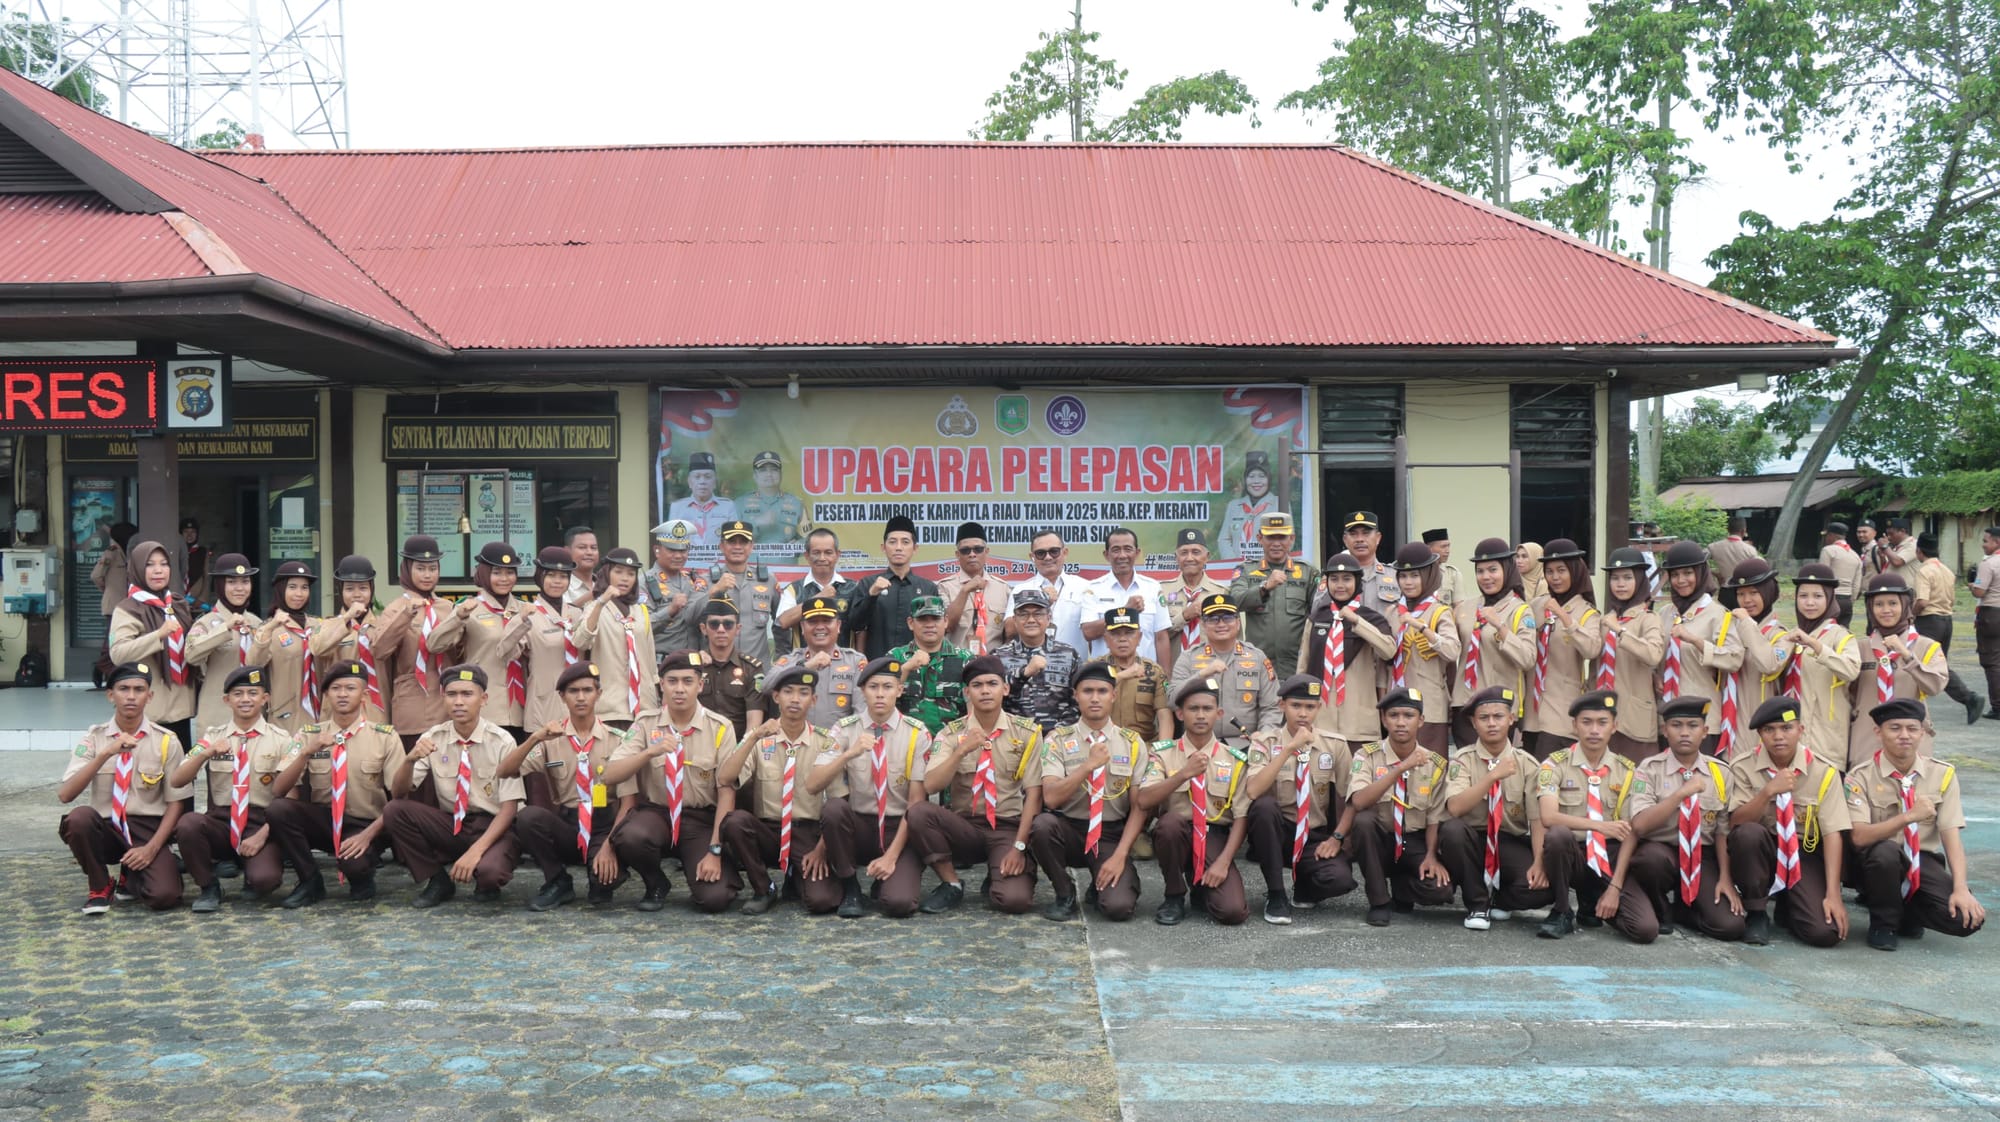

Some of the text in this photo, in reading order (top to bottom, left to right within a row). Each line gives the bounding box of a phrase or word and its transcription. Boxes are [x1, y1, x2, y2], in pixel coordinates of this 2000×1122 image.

[0, 372, 127, 420] RES
[252, 423, 309, 437] MASYARAKAT
[392, 425, 611, 449] SENTRA PELAYANAN KEPOLISIAN TERPADU
[108, 441, 273, 456] ADALA DAN KEWAJIBAN KAMI
[804, 446, 1222, 493] UPACARA PELEPASAN
[815, 503, 866, 521] PESERTA
[868, 503, 924, 521] JAMBORE
[927, 503, 990, 521] KARHUTLA
[993, 503, 1021, 520] RIAU
[1024, 503, 1063, 520] TAHUN
[1066, 503, 1098, 520] 2025
[1154, 502, 1208, 519] MERANTI
[922, 525, 955, 543] BUMI
[1040, 525, 1088, 543] HURA
[939, 563, 1009, 576] Selaang,
[1011, 563, 1025, 573] 23
